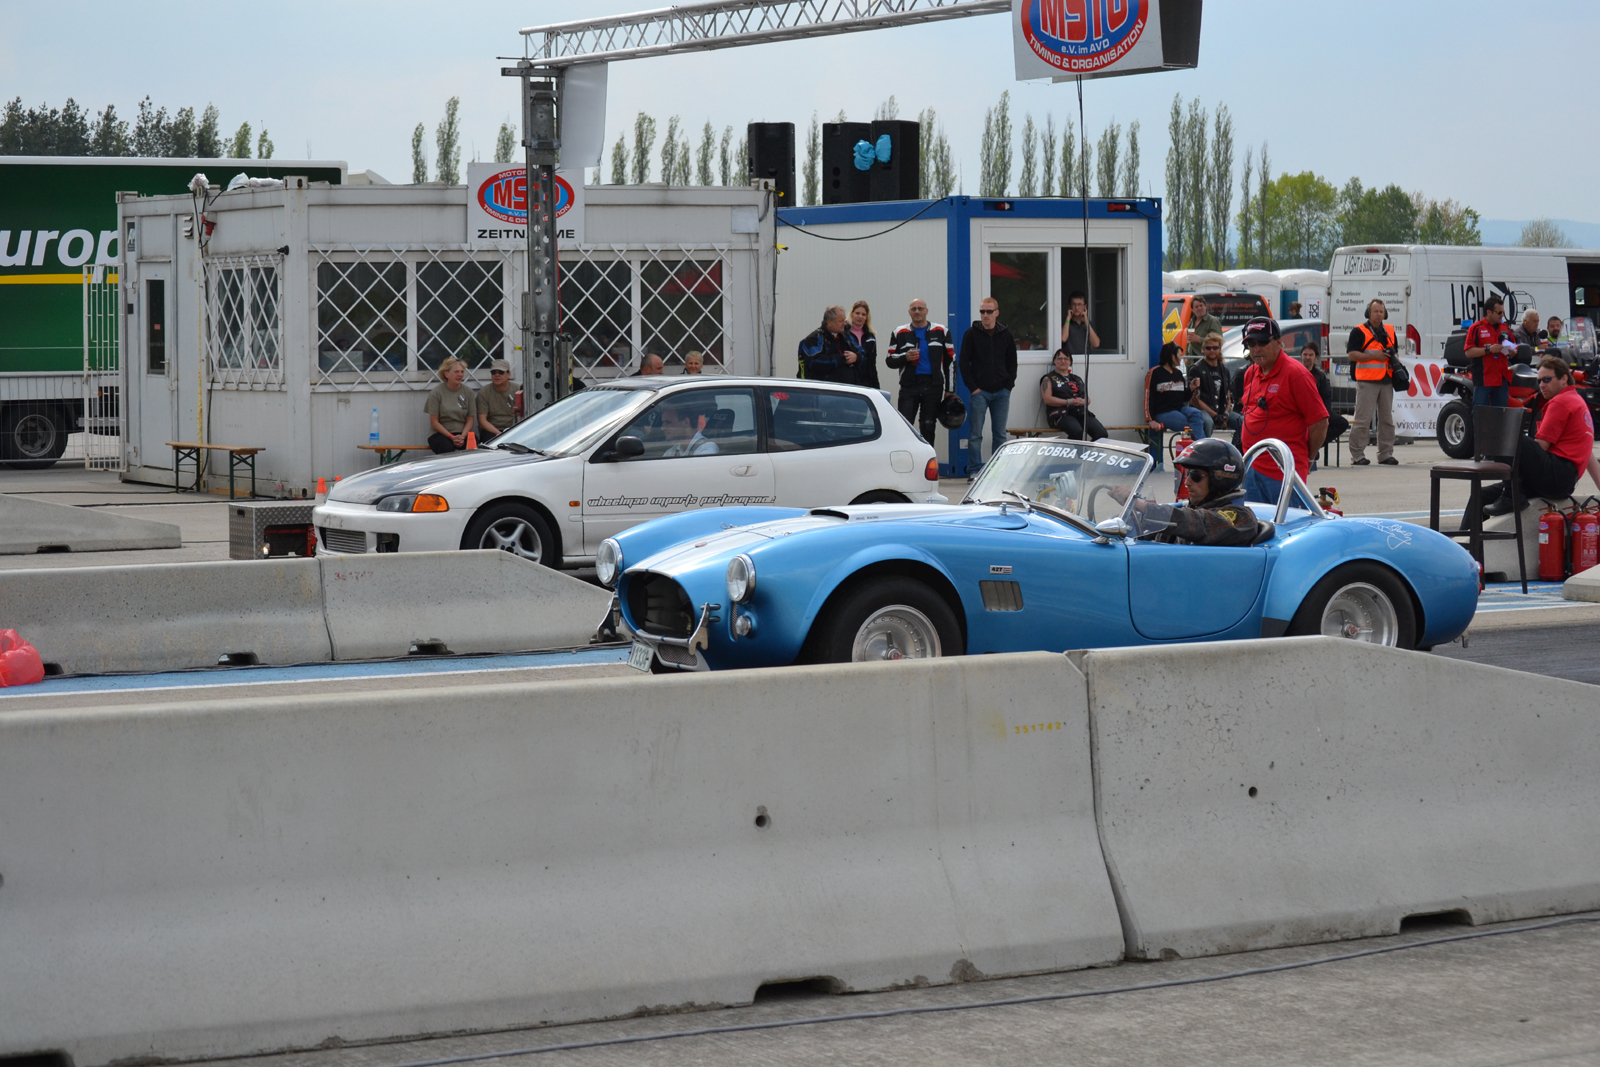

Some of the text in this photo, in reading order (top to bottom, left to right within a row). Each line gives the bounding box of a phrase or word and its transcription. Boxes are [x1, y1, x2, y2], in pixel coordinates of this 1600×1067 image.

[1029, 18, 1144, 70] TIMING & ORGANISATION
[1061, 45, 1078, 54] e.V.
[1078, 45, 1089, 54] im
[484, 203, 508, 221] TIMING
[477, 229, 575, 239] ZEITNME
[1037, 445, 1078, 459] COBRA
[1080, 450, 1107, 463] 427
[1106, 455, 1132, 469] S/C
